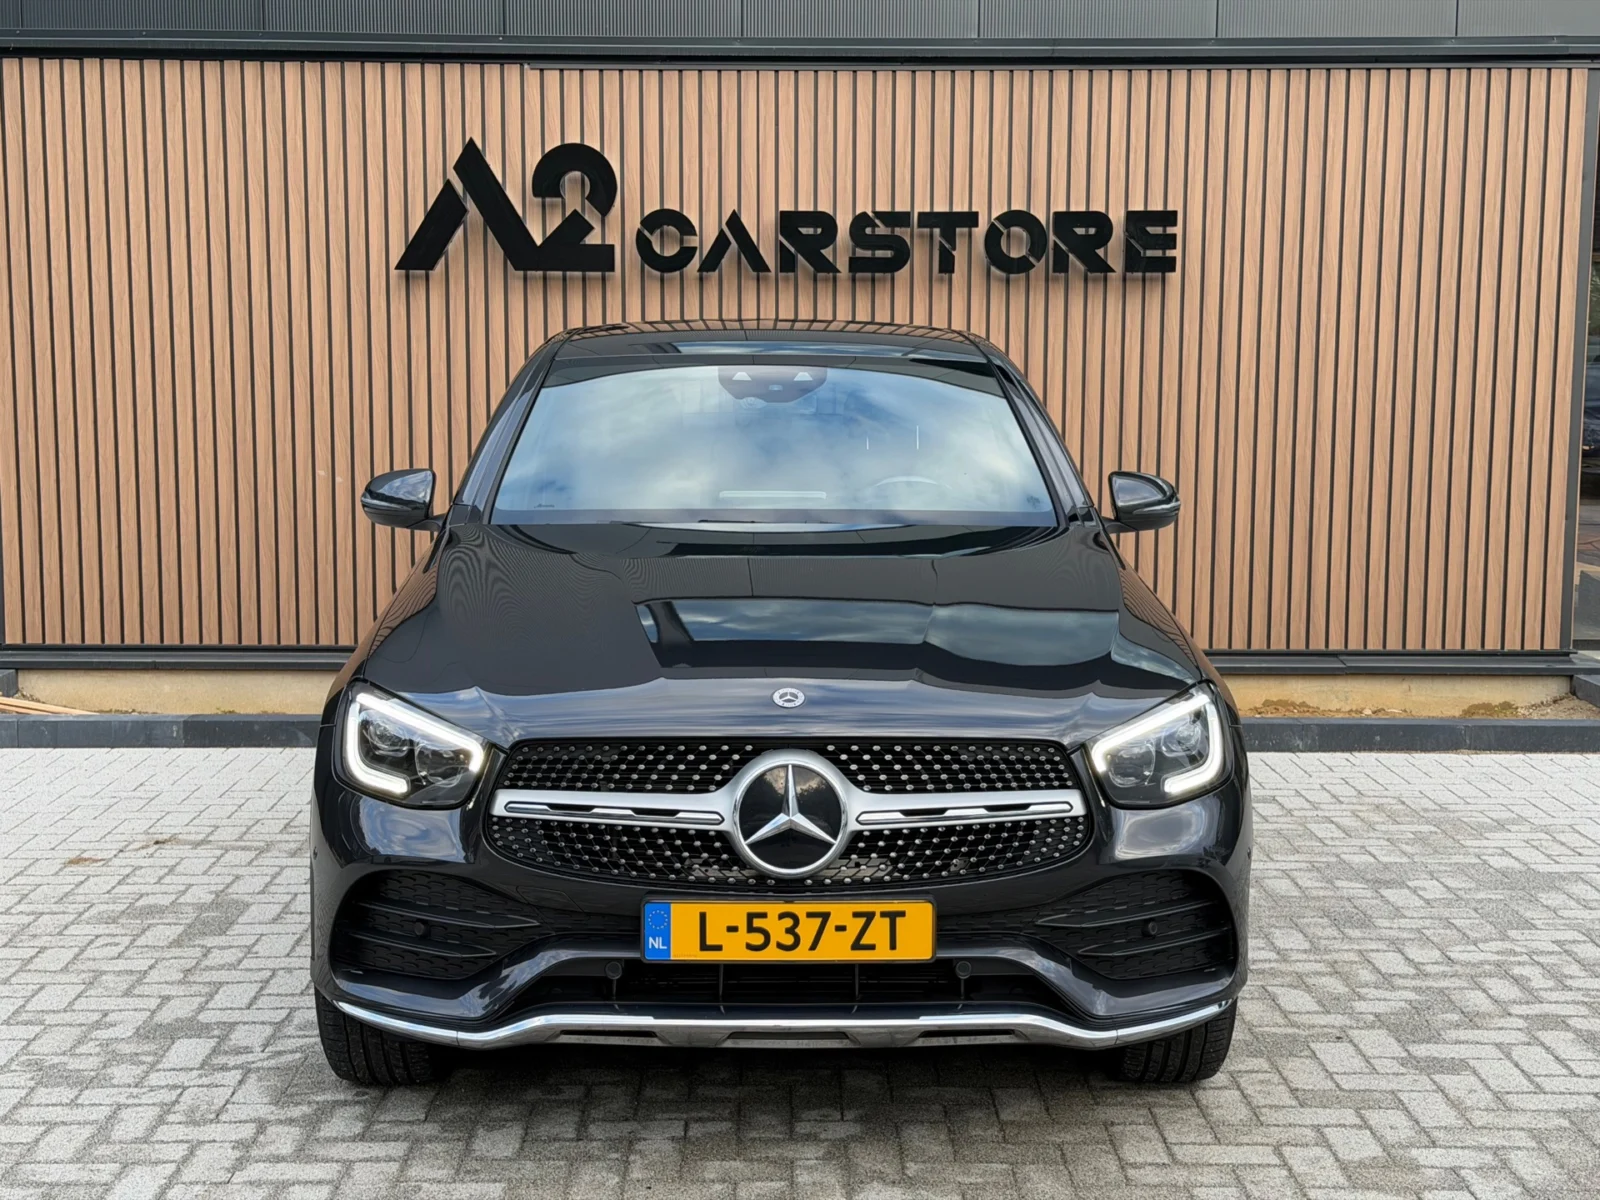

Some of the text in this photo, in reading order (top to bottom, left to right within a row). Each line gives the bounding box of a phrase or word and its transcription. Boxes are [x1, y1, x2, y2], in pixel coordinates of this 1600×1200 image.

[394, 137, 1177, 273] A2 CARSTORE
[648, 936, 667, 949] NL
[699, 910, 906, 952] L-537-ZT
